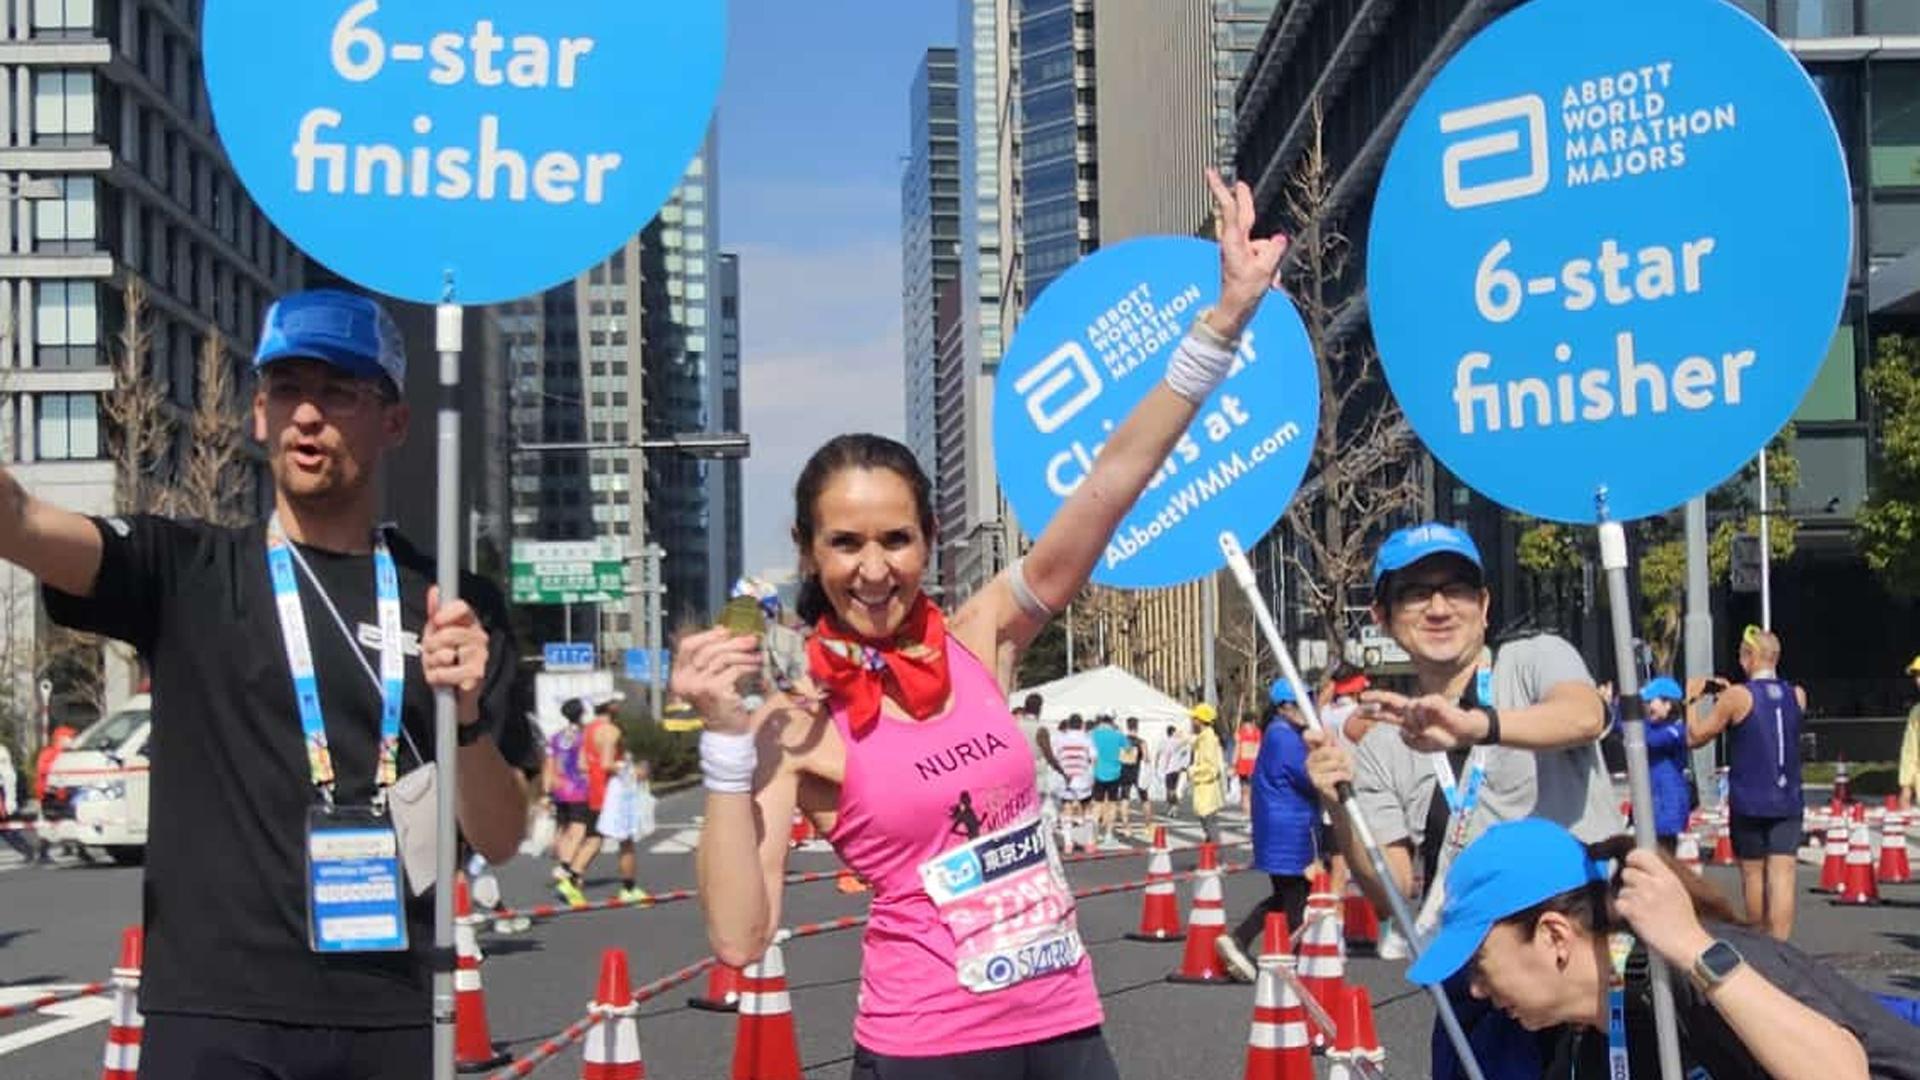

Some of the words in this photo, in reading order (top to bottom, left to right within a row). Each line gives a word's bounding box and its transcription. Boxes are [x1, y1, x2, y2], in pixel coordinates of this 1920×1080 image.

[331, 0, 594, 88] 6-star
[1563, 62, 1672, 109] ABBOTT
[1563, 93, 1664, 133] WORLD
[292, 108, 622, 204] finisher
[1566, 104, 1736, 161] MARATHON
[1567, 144, 1685, 188] MAJORS
[1475, 237, 1715, 322] 6-star
[1087, 282, 1150, 342] ABBOTT
[1092, 300, 1155, 352] WORLD
[1102, 284, 1200, 367] MARATHON
[1110, 323, 1182, 381] MAJORS
[1453, 331, 1755, 433] finisher
[1204, 395, 1249, 442] at
[1104, 421, 1300, 570] AbbottWMM.com
[915, 733, 1009, 780] NURIA
